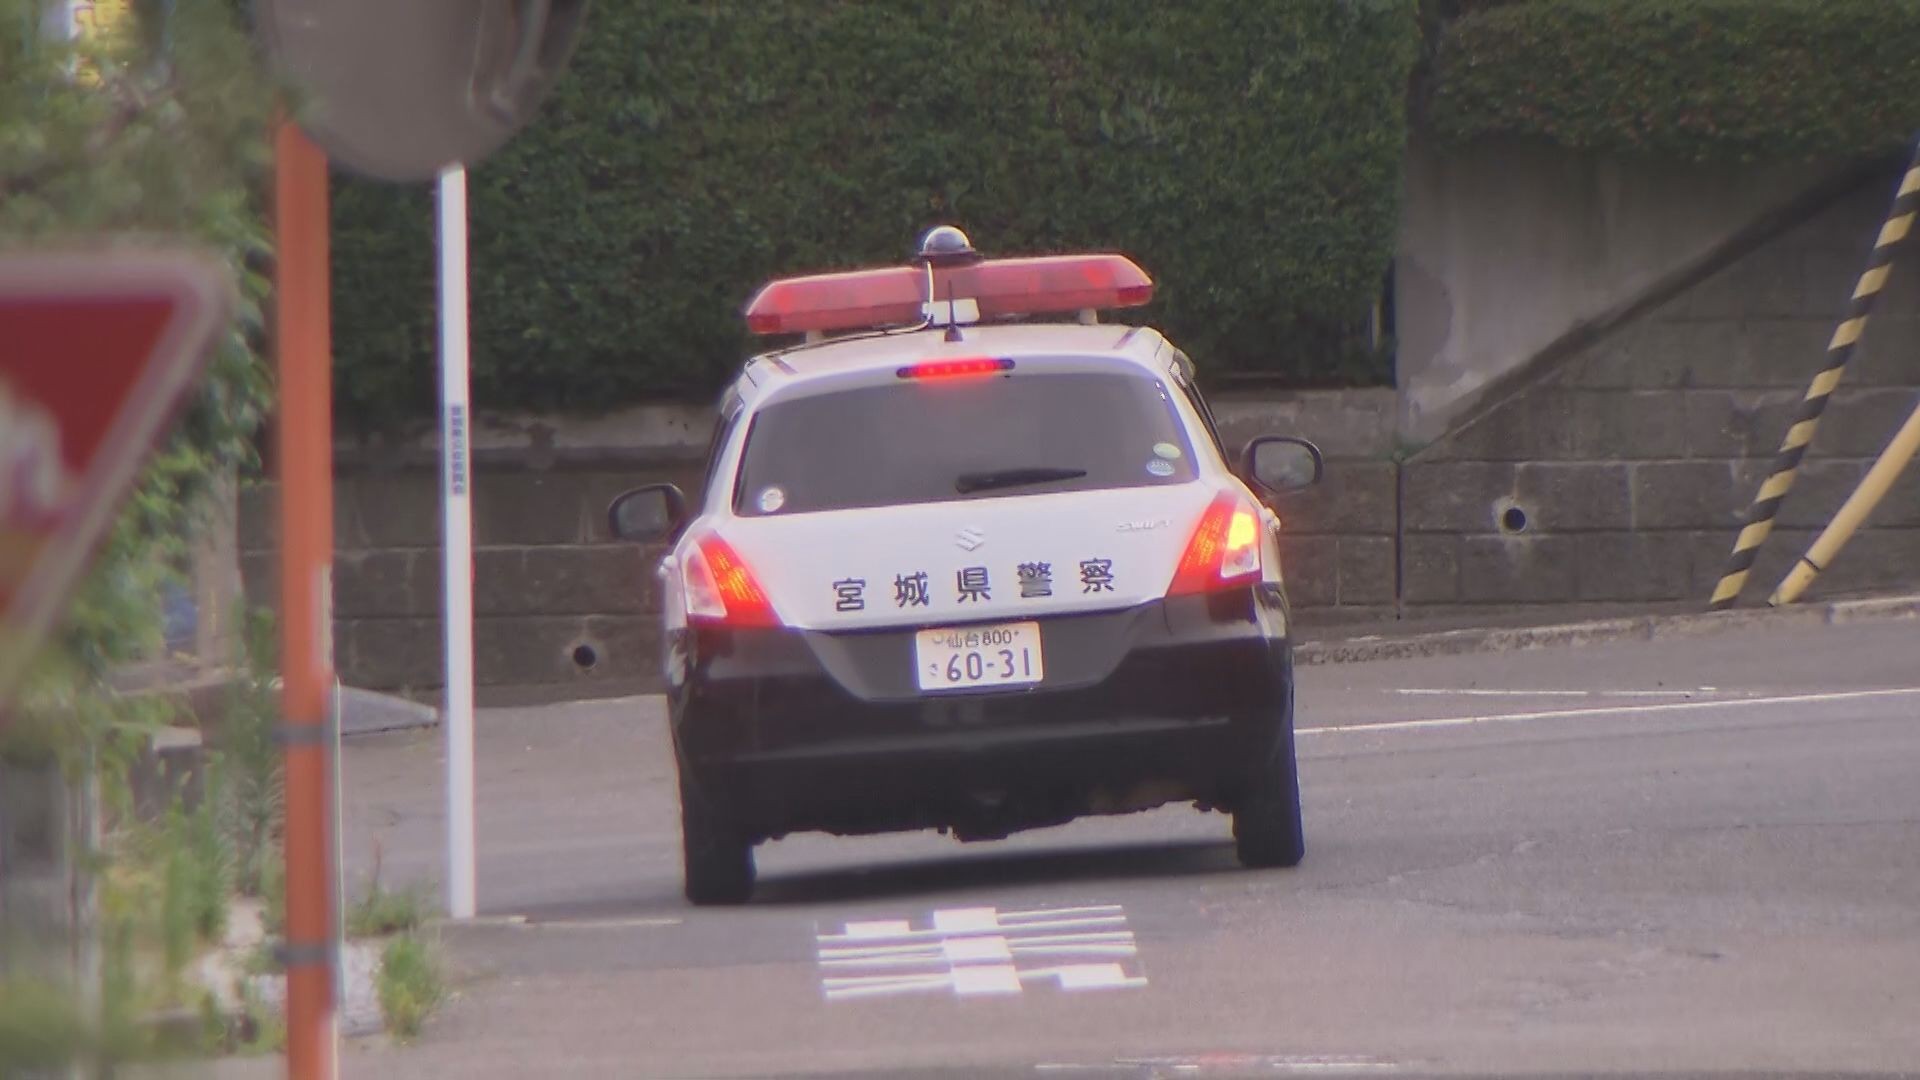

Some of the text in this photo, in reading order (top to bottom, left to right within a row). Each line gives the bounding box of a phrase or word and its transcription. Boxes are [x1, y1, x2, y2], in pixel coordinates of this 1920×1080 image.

[832, 557, 1115, 612] 宮城県警察
[946, 647, 1031, 682] 60-31
